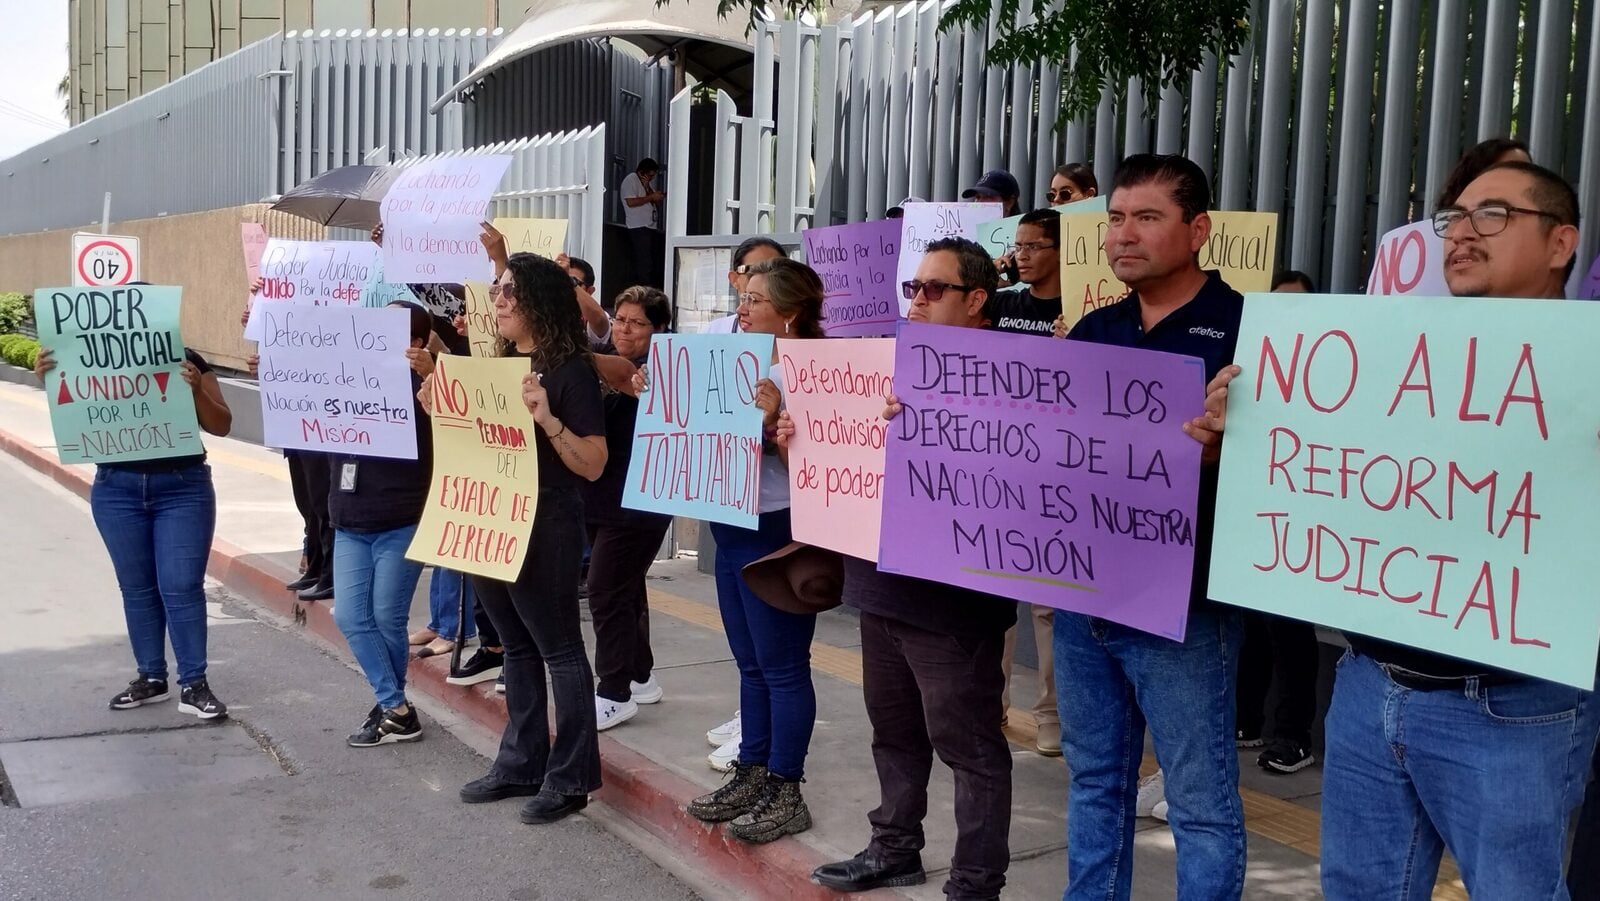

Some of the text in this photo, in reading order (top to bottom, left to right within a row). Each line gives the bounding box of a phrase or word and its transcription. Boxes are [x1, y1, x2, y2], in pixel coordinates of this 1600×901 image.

[396, 165, 481, 190] Luchando
[386, 193, 486, 225] por la justicia
[936, 206, 961, 230] SIN
[400, 229, 413, 249] la
[521, 229, 532, 248] A
[854, 243, 870, 265] por
[879, 234, 895, 257] la
[92, 257, 120, 280] 40
[415, 262, 437, 274] cia
[1369, 229, 1426, 296] NO
[261, 275, 295, 299] unido
[319, 281, 331, 297] la
[856, 275, 865, 296] y
[869, 266, 886, 284] la
[51, 288, 148, 335] PODER
[264, 311, 388, 352] Defender los
[75, 330, 183, 370] JUDICIAL
[263, 356, 381, 390] derechos de la
[645, 338, 691, 429] NO
[704, 349, 733, 414] AL
[782, 354, 895, 400] Defendamo
[911, 344, 1167, 424] DEFENDER LOS
[1256, 329, 1549, 440] NO A LA
[87, 402, 152, 425] POR LA
[266, 391, 409, 422] Nación es nuestra
[475, 387, 486, 410] a
[491, 382, 509, 414] la
[301, 417, 371, 445] Misión
[476, 417, 527, 448] PERDIDA
[806, 410, 824, 443] la
[898, 401, 1172, 488] DERECHOS DE LA
[496, 451, 518, 480] DEL
[797, 457, 819, 490] de
[439, 474, 532, 522] ESTADO DE
[908, 459, 1193, 547] NACIÓN ES NUESTRA
[1268, 427, 1542, 554] REFORMA
[436, 520, 518, 565] DERECHO
[952, 518, 1095, 581] MISIÓN
[1253, 512, 1552, 648] JUDICIAL
